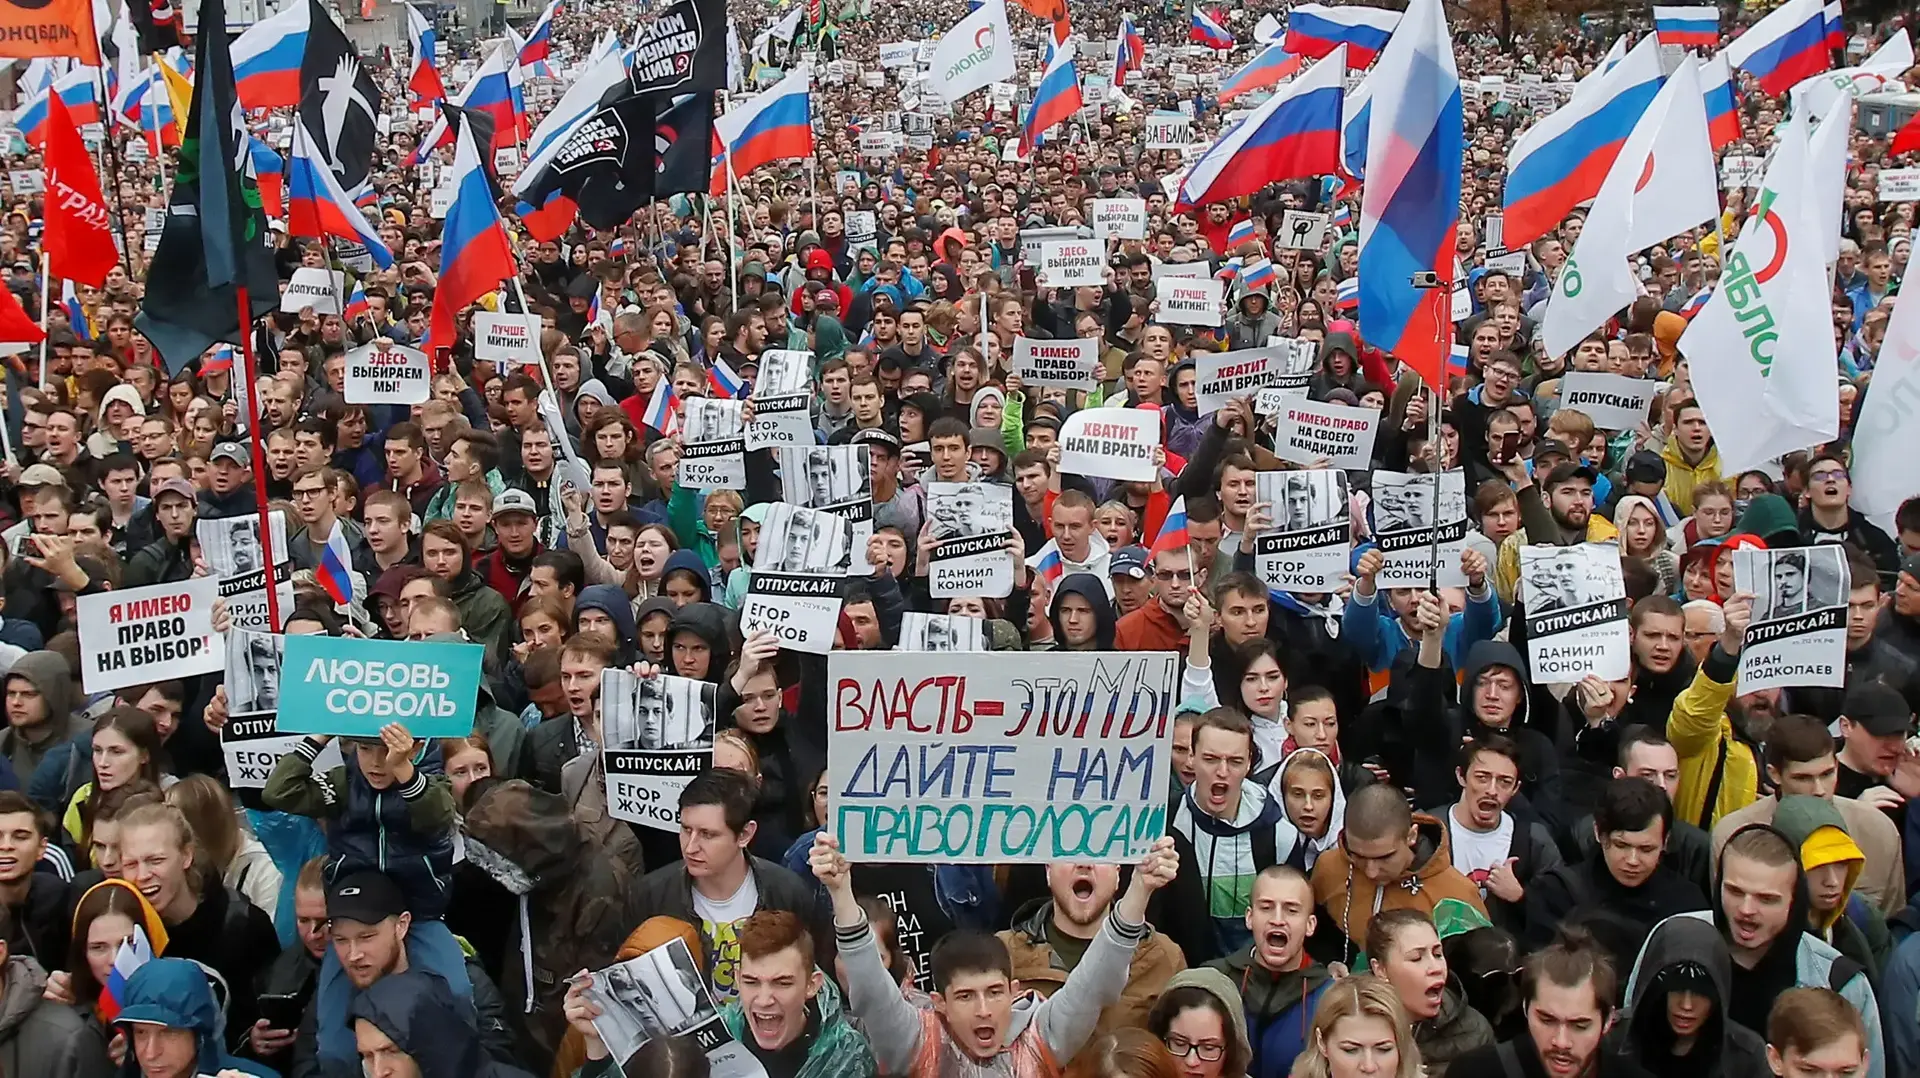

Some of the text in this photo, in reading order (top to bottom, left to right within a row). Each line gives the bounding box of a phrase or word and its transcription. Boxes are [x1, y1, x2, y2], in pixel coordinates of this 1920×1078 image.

[635, 30, 697, 69] МУНИЗА
[639, 57, 675, 82] ЦИЯ
[1105, 204, 1129, 213] ЗДЕСЬ
[1097, 213, 1139, 223] ВЫБИРАЕМ
[1107, 223, 1124, 231] МЫ!
[1059, 246, 1087, 256] ЗДЕСЬ
[1048, 256, 1100, 268] ВЫБИРАЕМ
[1064, 268, 1084, 278] МЫ!
[1172, 288, 1207, 299] ЛУЧШЕ
[1167, 299, 1210, 311] МИТИНГ!
[1724, 251, 1779, 378] ЯБЛО
[492, 324, 526, 336] ЛУЧШЕ
[487, 335, 529, 348] МИТИНГ!
[369, 352, 407, 364] ЗДЕСЬ
[1030, 347, 1080, 358] Я ИМЕЮ
[1034, 359, 1076, 369] ПРАВО
[1217, 358, 1268, 378] ХВАТИТ
[352, 366, 423, 380] ВЫБИРАЕМ
[1021, 369, 1089, 381] НА ВЫБОР!
[373, 380, 400, 393] МЫ!
[1202, 369, 1279, 395] НАМ ВРАТЬ!
[754, 398, 802, 412] ТПУСКАЙ!
[1568, 391, 1644, 410] ДОПУСКАЙ!
[750, 421, 778, 432] ЕГОР
[1288, 410, 1369, 431] Я ИМЕЮ ПРАВО
[750, 432, 794, 443] ЖУКОВ
[1082, 422, 1139, 440] ХВАТИТ
[1298, 426, 1355, 443] НА СВОЕГО
[686, 442, 741, 456] ОТПУСКАЙ!
[1065, 437, 1151, 459] НАМ ВРАТЬ!
[1290, 436, 1358, 456] КАНДИДАТА!
[685, 464, 715, 474] ЕГОР
[685, 474, 729, 484] ЖУКОВ
[1266, 529, 1342, 550] ОТПУСКАЙ!
[1382, 527, 1460, 549] ОТПУСКАЙ!
[936, 536, 1006, 557] ОТПУСКАЙ!
[1266, 561, 1305, 571] ЕГОР
[1382, 559, 1446, 569] ДАНИИЛ
[937, 568, 993, 579] ДАНИИЛ
[1266, 572, 1325, 586] ЖУКОВ
[1382, 570, 1432, 580] КОНОН
[756, 577, 836, 593] ОТПУСКАЙ!
[937, 580, 983, 590] КОНОН
[109, 593, 191, 624] Я ИМЕЮ
[751, 603, 790, 622] ЕГОР
[1535, 604, 1618, 633] ОТПУСКАЙ!
[117, 617, 185, 645] ПРАВО
[747, 617, 808, 642] ЖУКОВ
[1746, 611, 1835, 643] ОТПУСКАЙ!
[97, 636, 209, 672] НА ВЫБОР!
[1538, 645, 1605, 660] ДАНИИЛ
[1540, 660, 1593, 673] КОНОН
[1746, 655, 1782, 669] ИВАН
[304, 658, 451, 689] ЛЮБОВЬ
[1745, 665, 1833, 682] ПОДКОПАЕВ
[326, 688, 457, 718] СОБОЛЬ
[1073, 657, 1175, 739] МЫ
[235, 750, 281, 767] ЕГОР
[615, 755, 702, 771] ОТПУСКАЙ!
[840, 741, 1155, 801] ДАЙТЕ НАМ
[617, 782, 661, 803] ЕГОР
[617, 798, 681, 824] ЖУКОВ
[836, 803, 973, 857] ПРАВО
